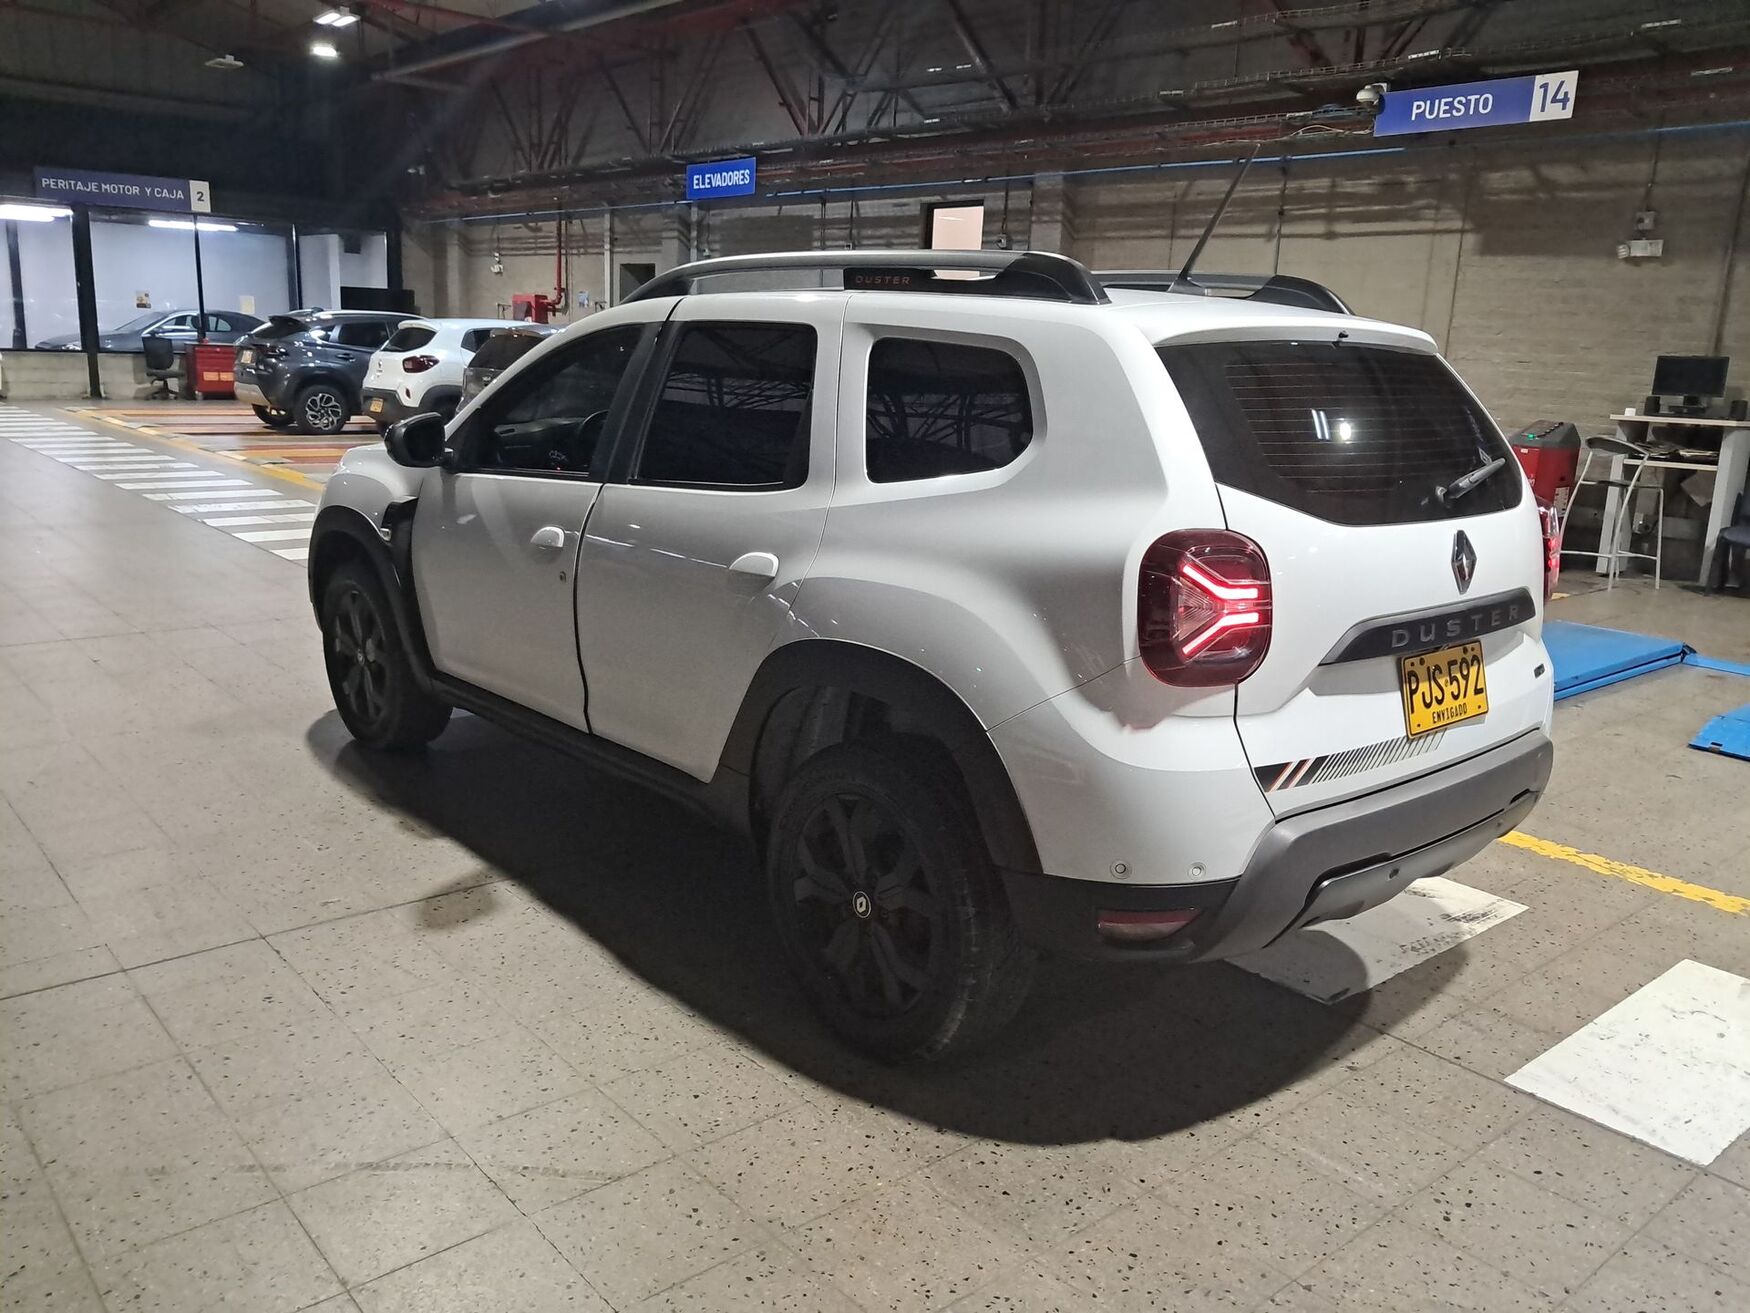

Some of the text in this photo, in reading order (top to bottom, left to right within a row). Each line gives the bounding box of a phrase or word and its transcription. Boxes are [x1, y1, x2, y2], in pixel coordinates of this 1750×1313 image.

[1411, 80, 1570, 121] PUESTO 14
[41, 177, 205, 202] PERITAJE MOTOR Y CAJA 2
[693, 168, 751, 190] ELEVADORES
[1391, 604, 1519, 648] DUSTER
[1432, 702, 1468, 724] ENVIGADO
